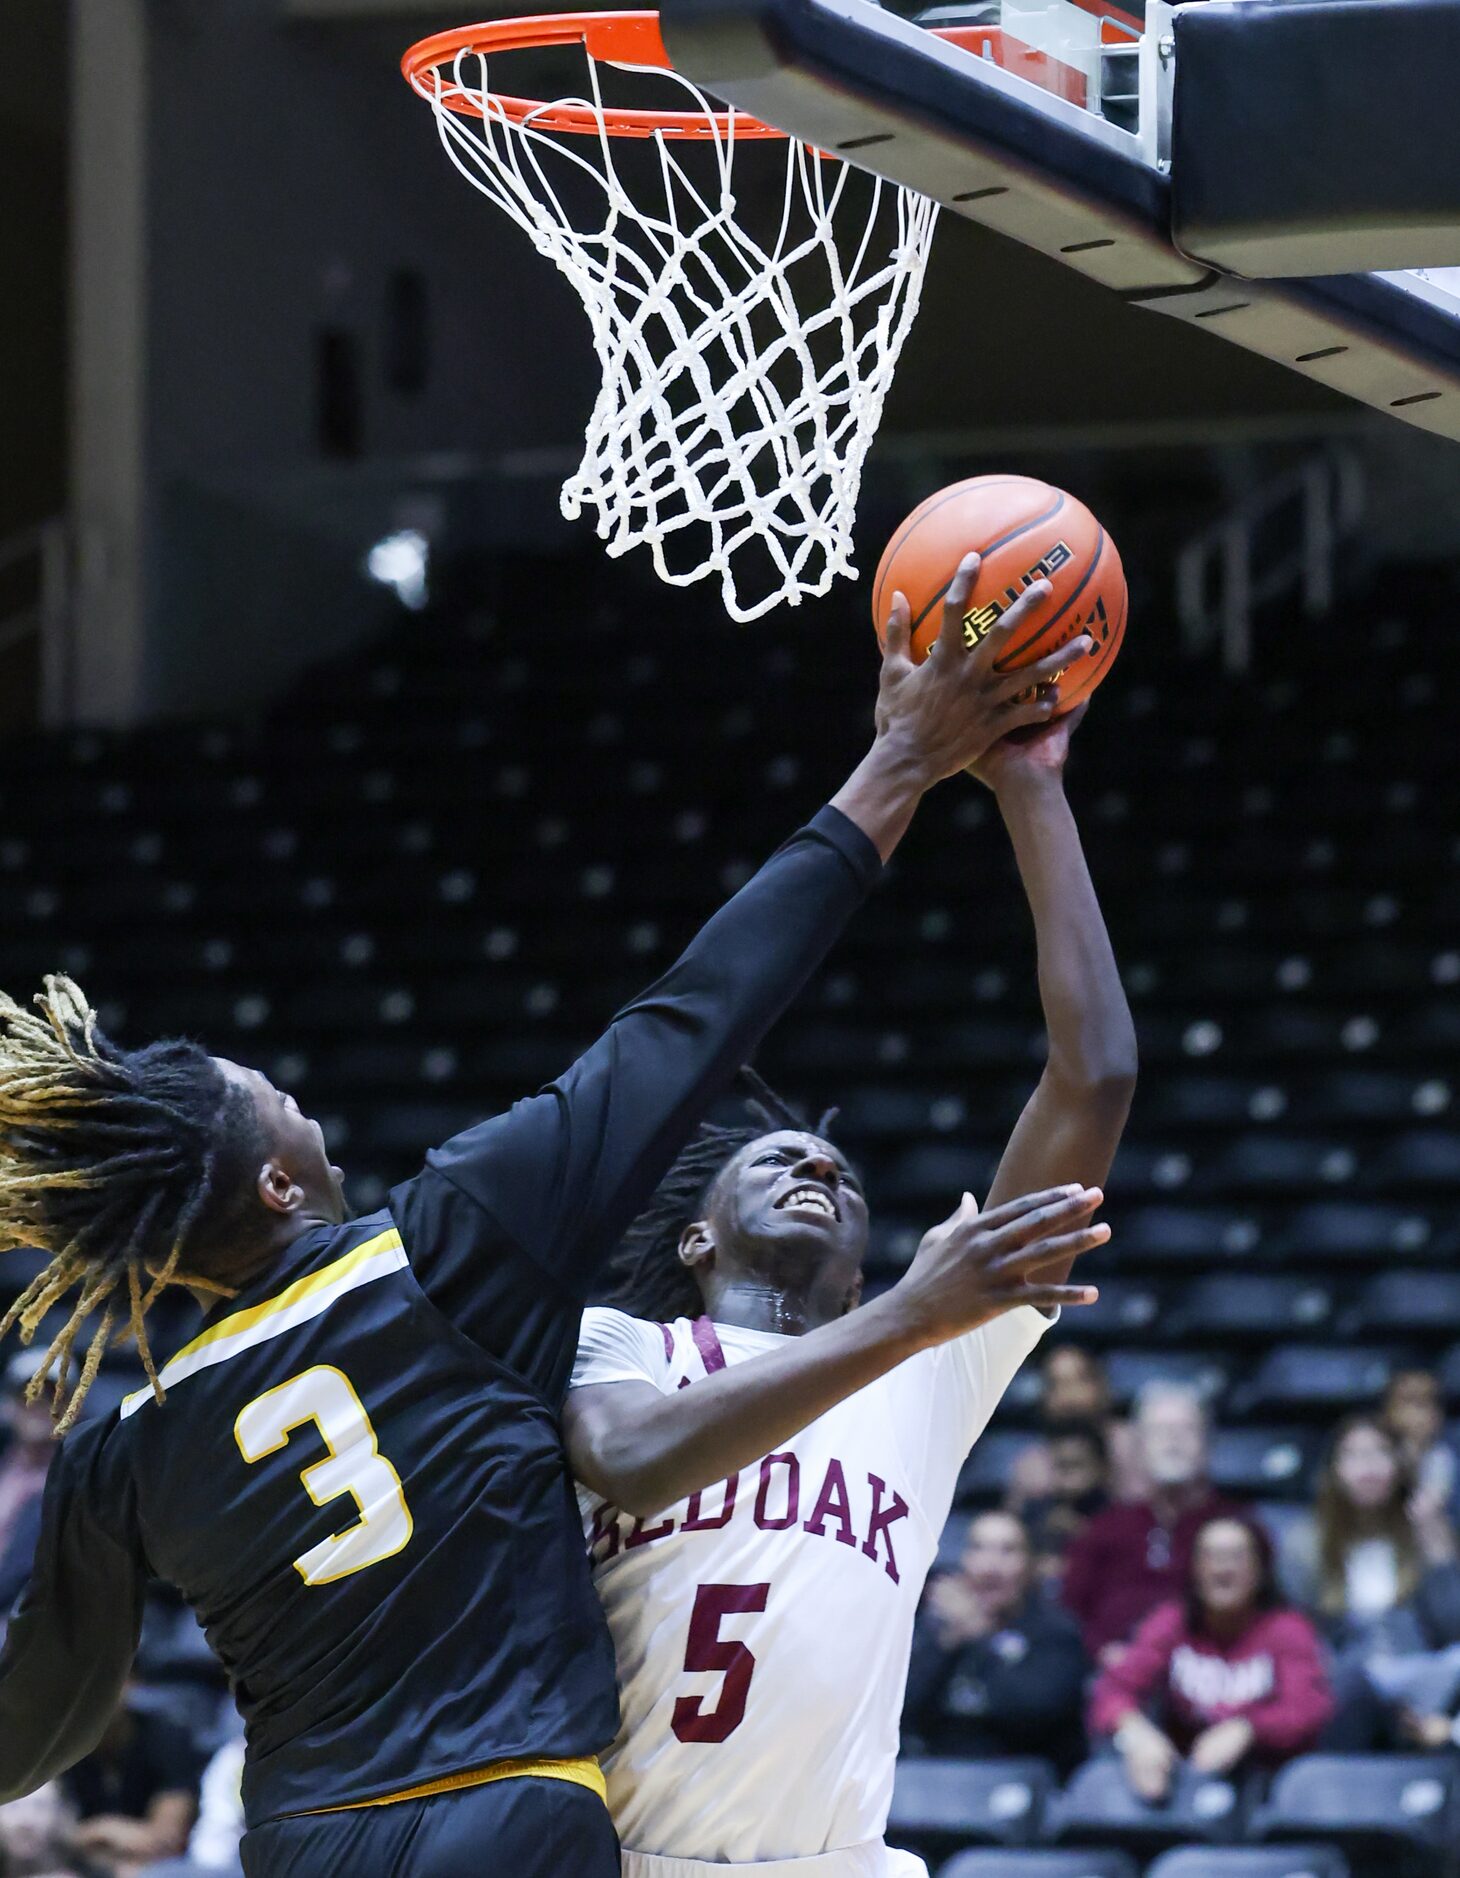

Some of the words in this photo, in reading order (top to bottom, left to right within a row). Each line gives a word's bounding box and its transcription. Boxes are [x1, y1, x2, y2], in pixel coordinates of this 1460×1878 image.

[234, 1365, 413, 1586] 3
[754, 1452, 909, 1586] OAK
[671, 1583, 771, 1743] 5
